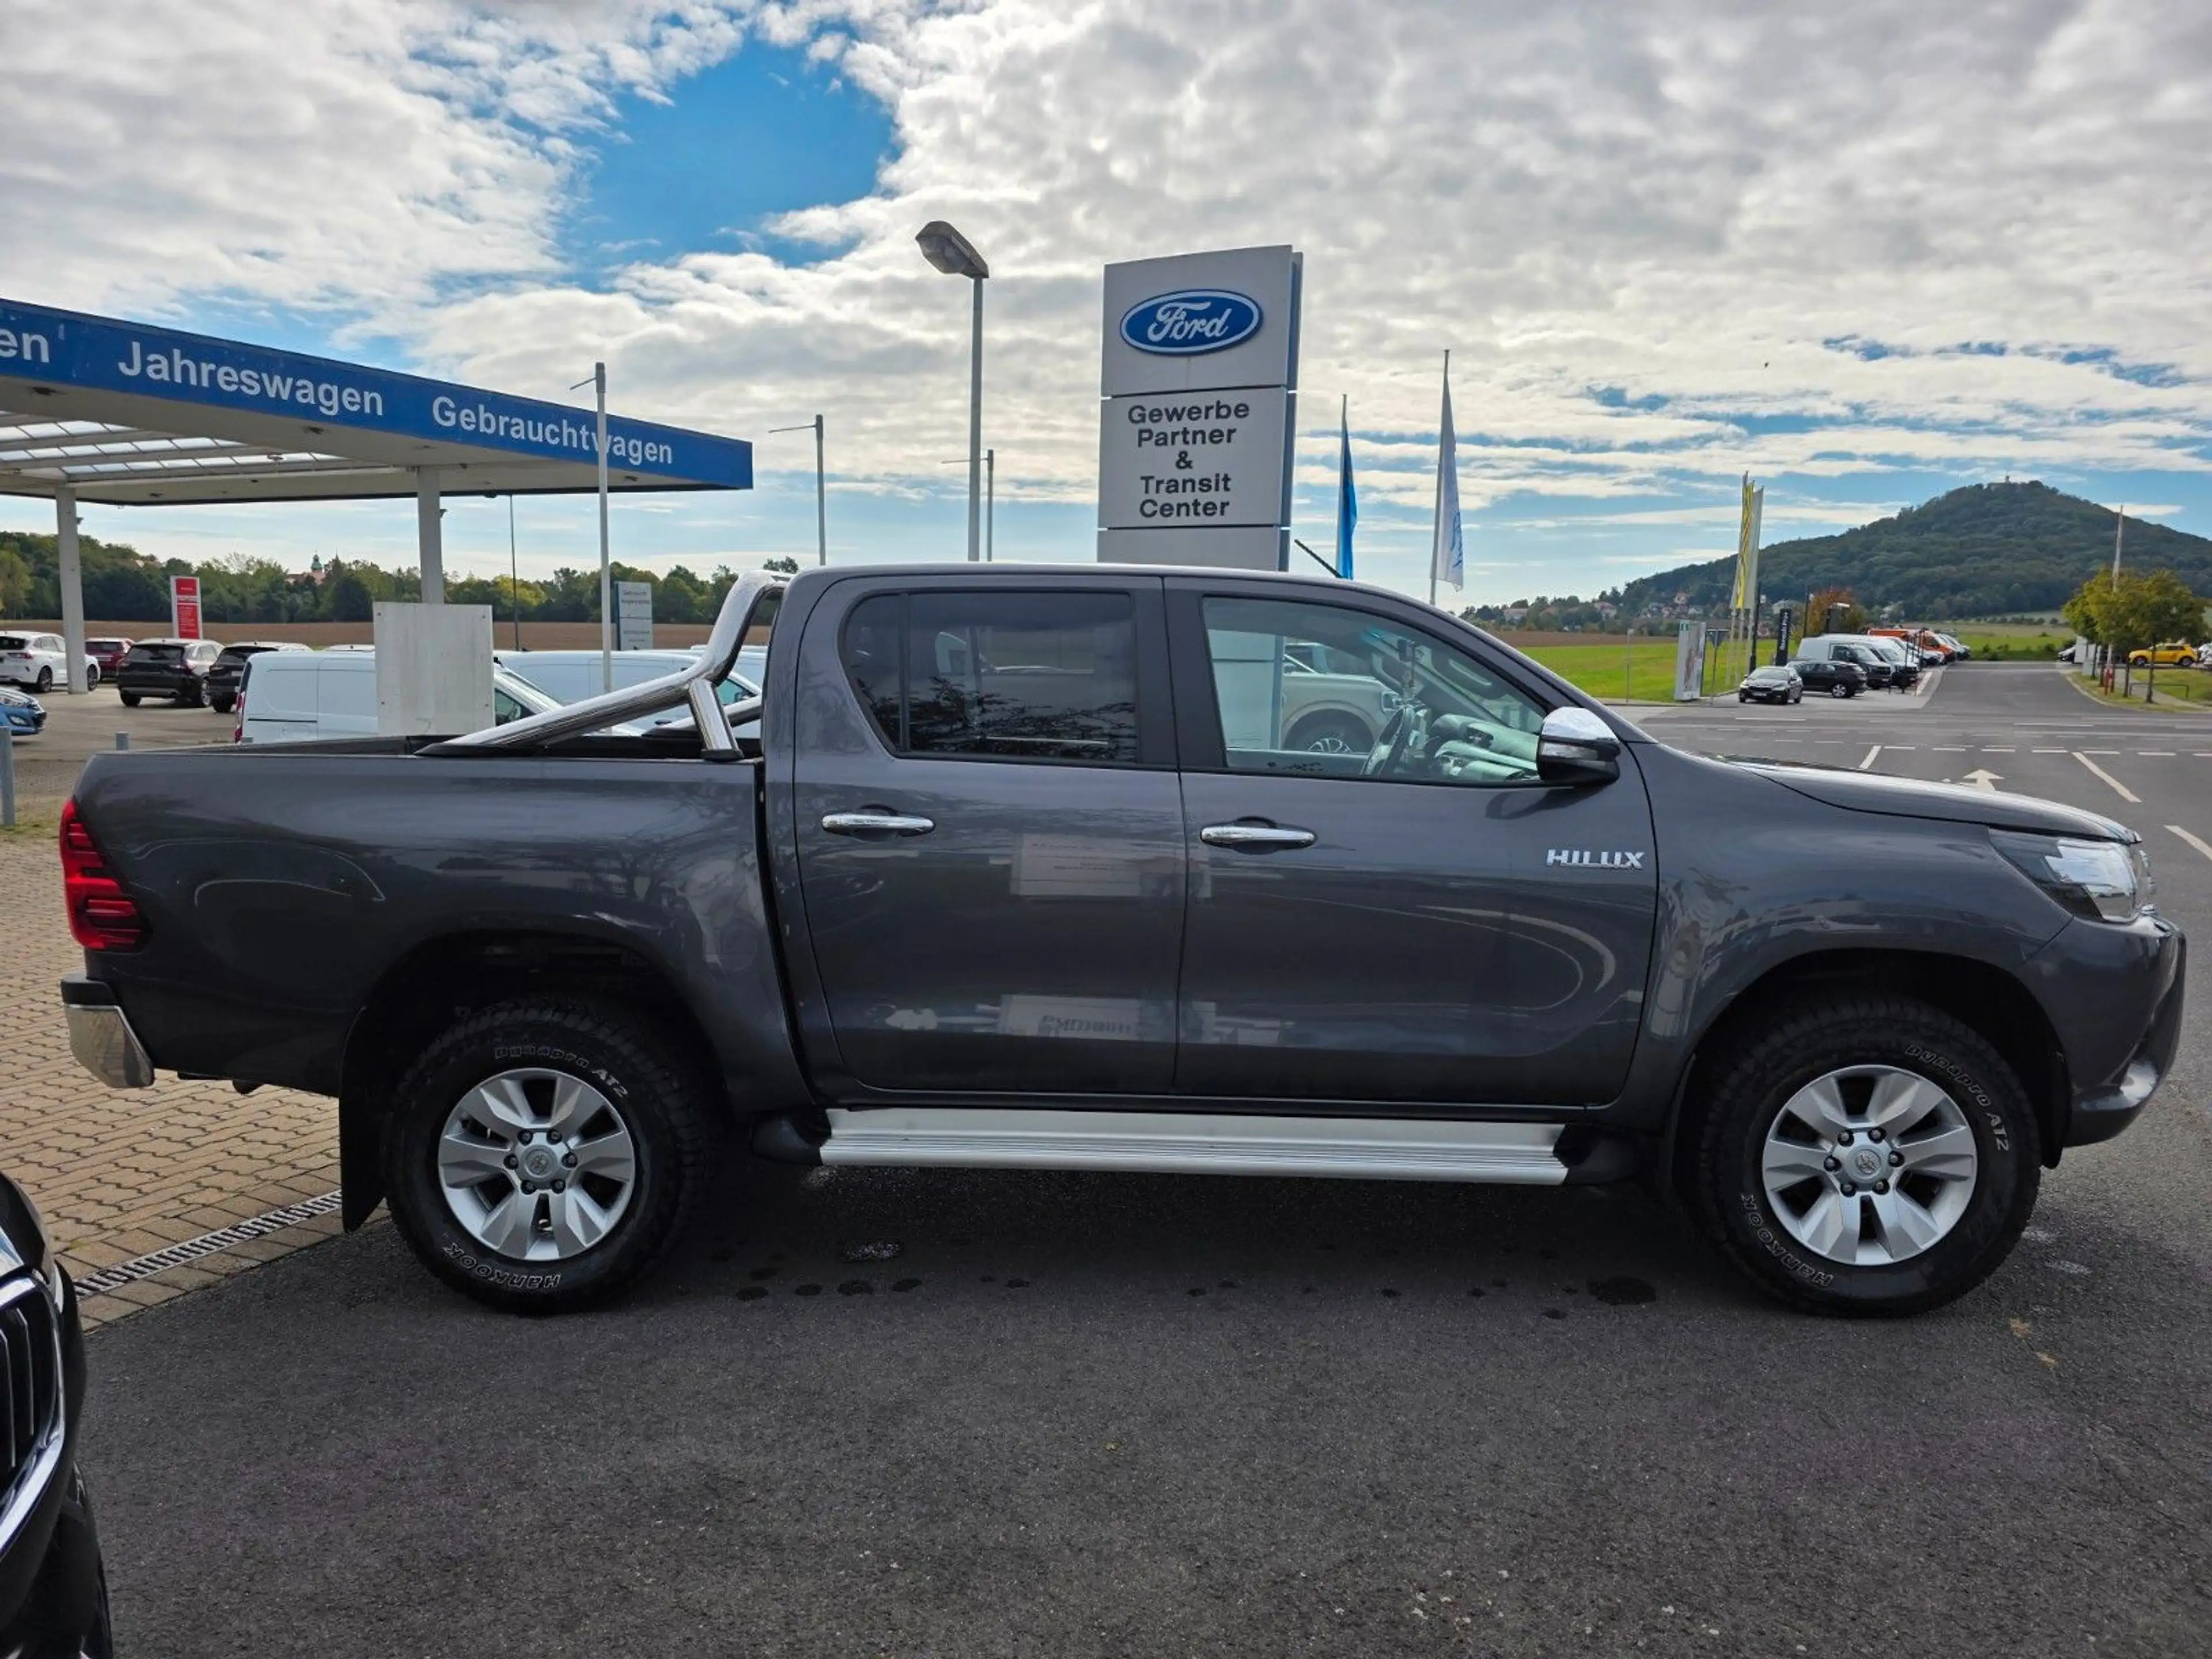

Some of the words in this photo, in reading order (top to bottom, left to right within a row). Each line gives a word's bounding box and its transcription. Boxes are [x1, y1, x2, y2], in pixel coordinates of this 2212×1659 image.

[1147, 301, 1232, 342] Ford
[118, 342, 383, 415] Jahreswagen
[1128, 400, 1249, 424] Gewerbe
[1138, 427, 1236, 448] Partner
[1176, 451, 1194, 469] &
[1141, 473, 1232, 494] Transit
[1139, 499, 1230, 518] Center
[1546, 849, 1645, 869] HILUX
